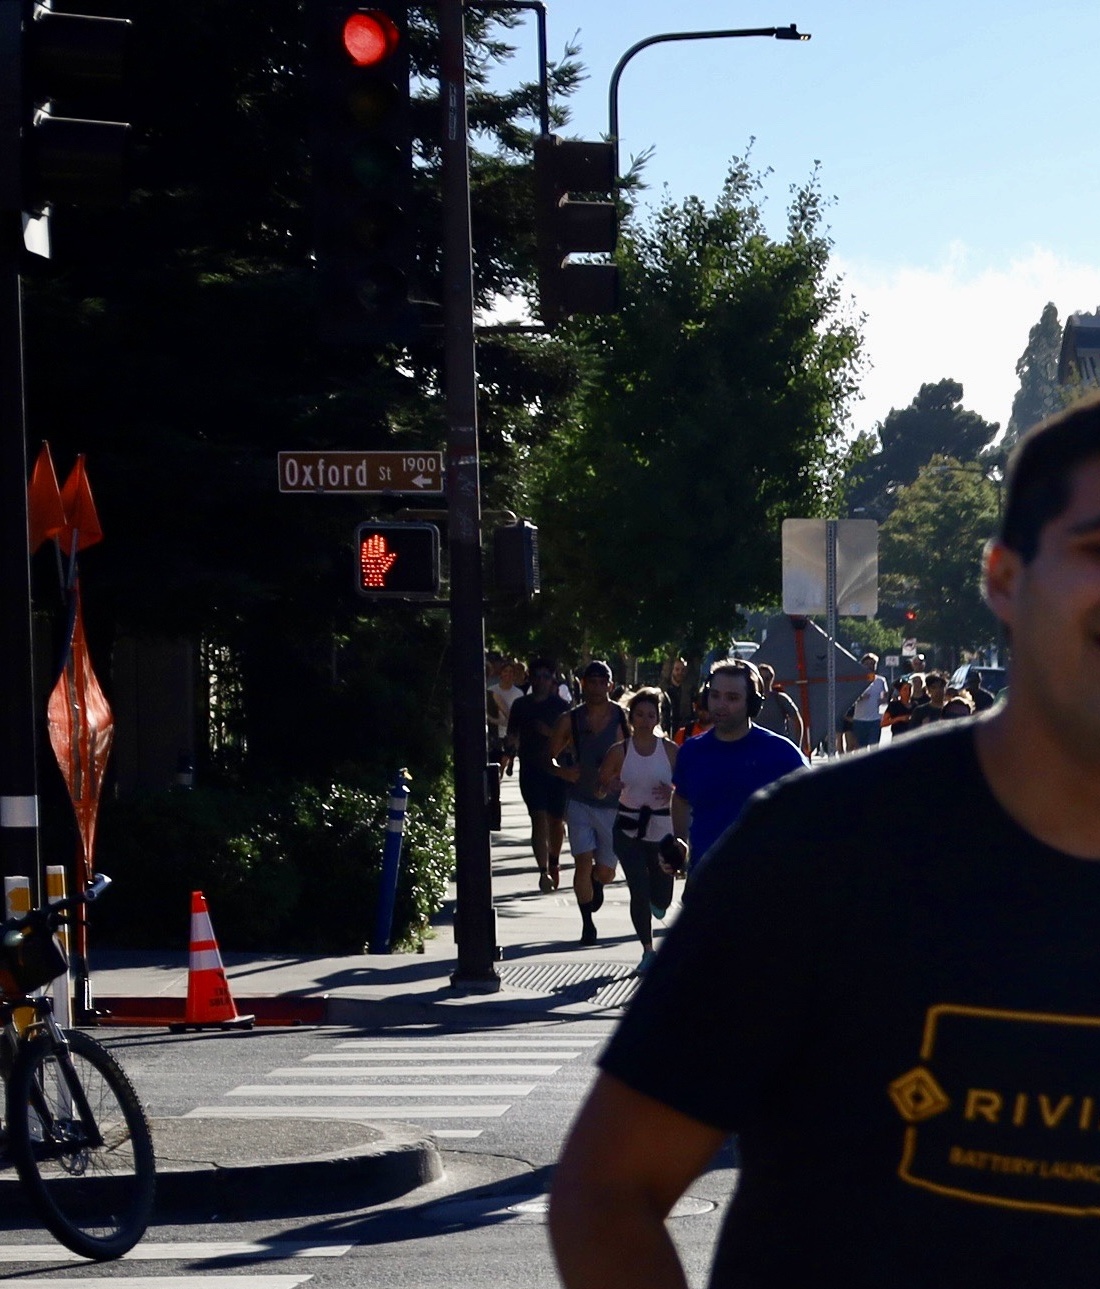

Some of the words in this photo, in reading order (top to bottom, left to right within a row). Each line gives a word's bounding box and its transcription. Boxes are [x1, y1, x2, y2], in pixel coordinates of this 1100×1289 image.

[285, 458, 367, 487] Oxford
[378, 466, 392, 481] St
[402, 457, 437, 473] 1900
[947, 1144, 1038, 1176] BATTERY
